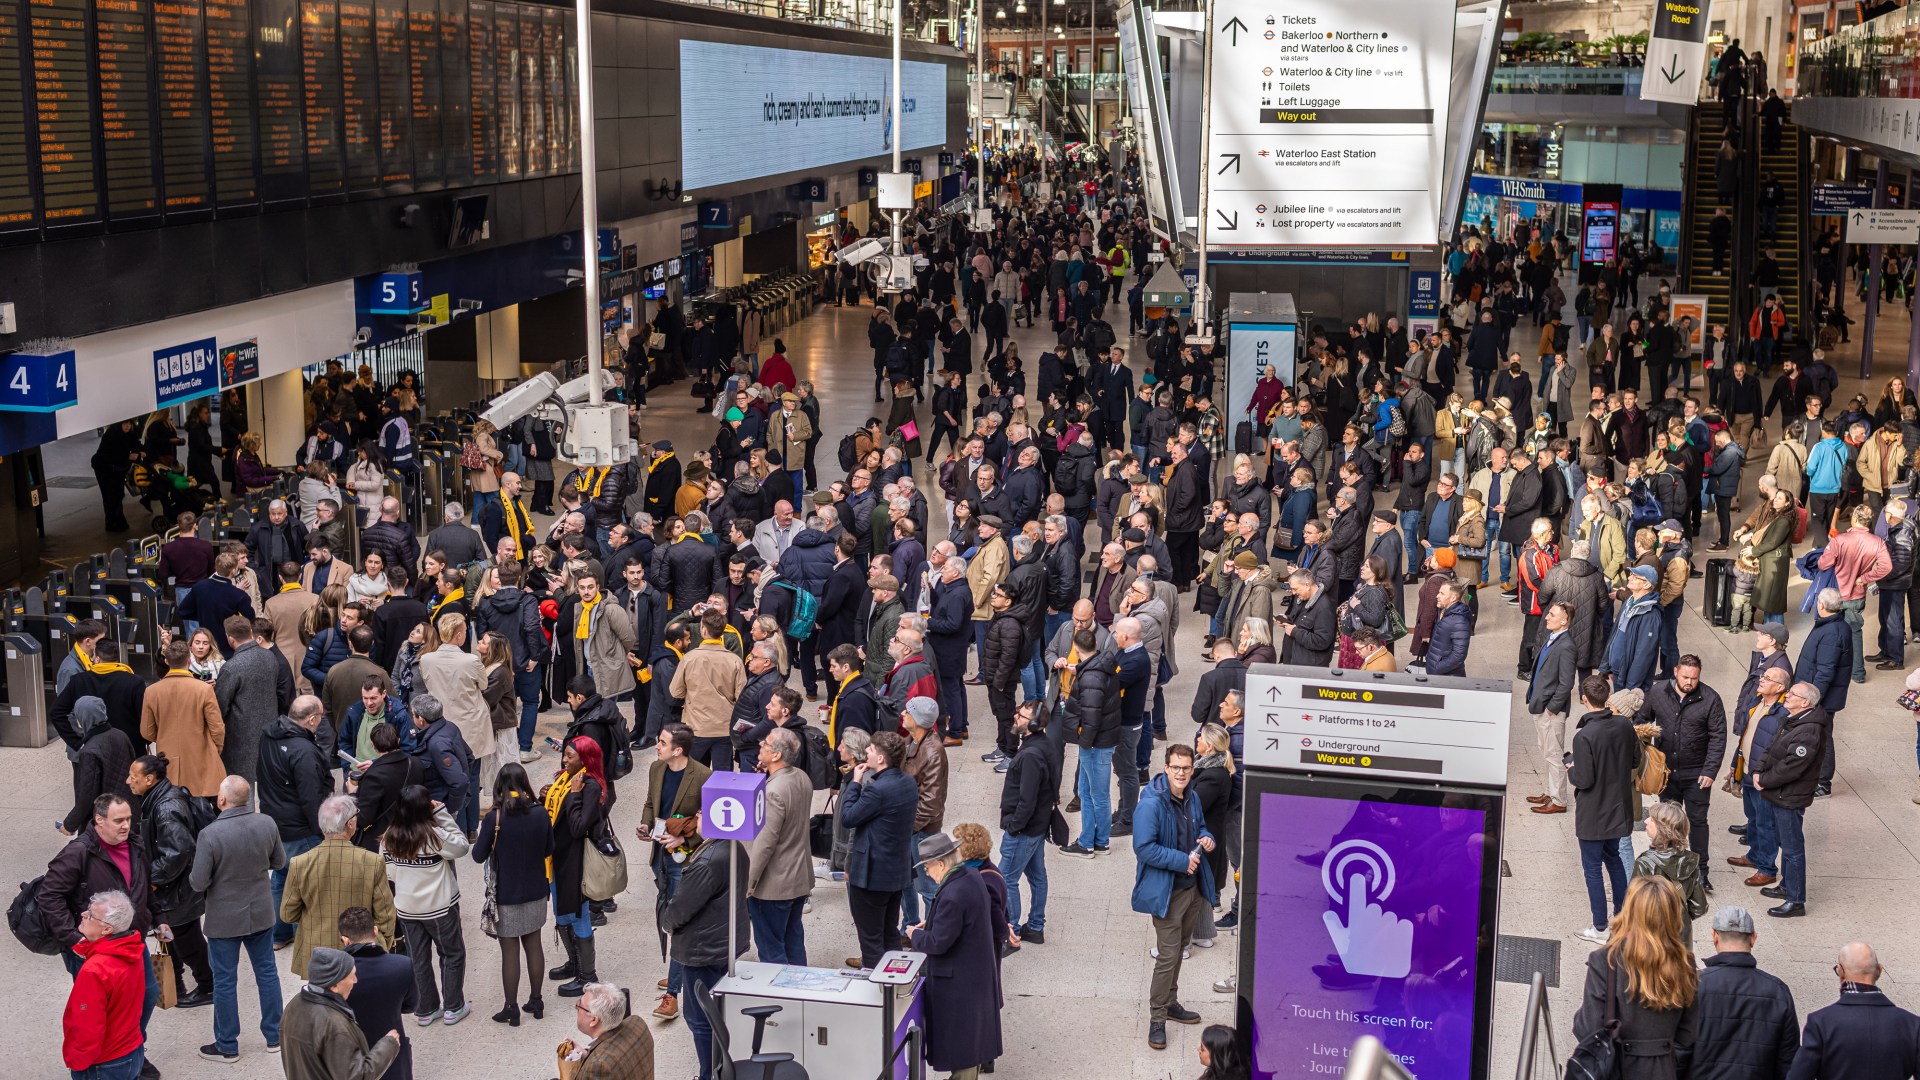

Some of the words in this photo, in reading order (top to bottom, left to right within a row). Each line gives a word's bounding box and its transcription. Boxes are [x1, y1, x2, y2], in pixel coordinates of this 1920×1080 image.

[1666, 2, 1700, 14] Waterloo
[1282, 16, 1316, 24] Tickets
[1671, 14, 1690, 24] Road
[1282, 31, 1323, 40] Bakerloo
[1336, 31, 1378, 40] Northern
[1281, 44, 1298, 52] and
[1301, 44, 1344, 52] Waterloo
[1347, 44, 1353, 52] &
[1356, 44, 1374, 54] City
[1377, 44, 1398, 52] lines
[1280, 68, 1323, 76] Waterloo
[1326, 68, 1332, 76] &
[1335, 68, 1353, 78] City
[1356, 68, 1372, 76] line
[1279, 82, 1310, 91] Toilets
[1278, 97, 1297, 106] Left
[1300, 97, 1340, 108] Luggage
[779, 100, 799, 127] creamy
[800, 92, 810, 119] and
[1278, 112, 1298, 121] Way
[1276, 150, 1318, 158] Waterloo
[1321, 150, 1340, 158] East
[1343, 150, 1376, 158] Station
[1546, 144, 1559, 177] PRET
[908, 163, 919, 172] 10
[866, 173, 873, 183] 9
[811, 185, 818, 197] 8
[1502, 180, 1545, 199] WHSmith
[711, 208, 719, 221] 7
[1273, 205, 1306, 213] Jubilee
[1309, 205, 1324, 213] line
[1273, 219, 1292, 227] Lost
[1294, 220, 1334, 229] property
[382, 282, 396, 302] 5
[412, 281, 418, 302] 5
[244, 346, 257, 359] WiFi
[10, 366, 30, 395] 4
[56, 363, 68, 392] 4
[159, 386, 171, 396] Wide
[172, 381, 191, 392] Platform
[191, 378, 202, 388] Gate
[1318, 688, 1338, 700] Way
[1340, 691, 1357, 700] out
[1319, 715, 1364, 726] Platforms
[1384, 720, 1396, 728] 24
[1318, 740, 1380, 752] Underground
[1317, 754, 1338, 766] Way
[1340, 756, 1355, 765] out
[1292, 1005, 1331, 1020] Touch
[1336, 1008, 1360, 1023] this
[1363, 1013, 1406, 1028] screen
[1411, 1017, 1433, 1030] for:
[1313, 1043, 1338, 1057] Live
